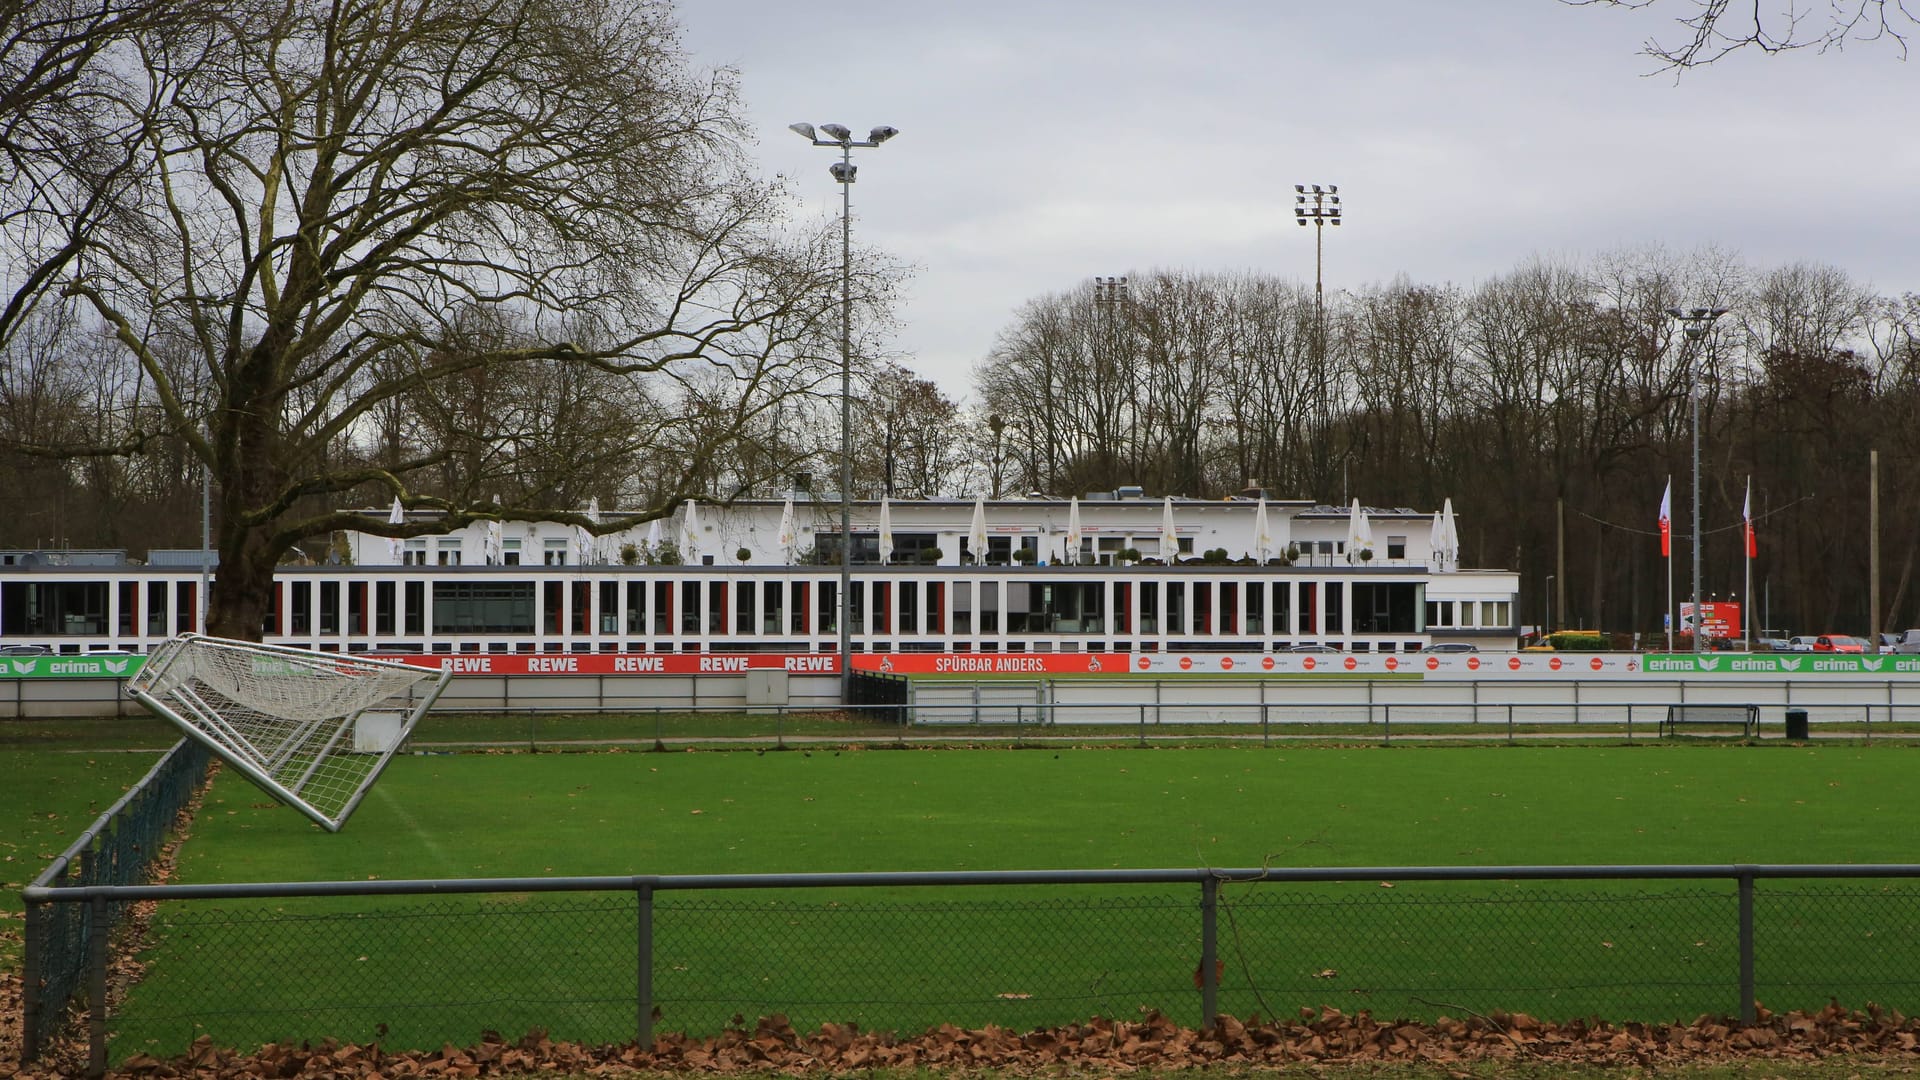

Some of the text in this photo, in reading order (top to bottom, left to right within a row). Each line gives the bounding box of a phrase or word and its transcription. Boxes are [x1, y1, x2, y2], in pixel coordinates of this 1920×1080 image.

[50, 660, 100, 674] erima
[441, 658, 491, 672] REWE
[528, 658, 577, 672] REWE
[614, 658, 664, 671] REWE
[700, 657, 748, 671] REWE
[785, 657, 833, 671] REWE
[936, 655, 1047, 672] SPÜRBAR ANDERS.
[1649, 658, 1694, 670] erima
[1731, 658, 1776, 670] erima
[1813, 658, 1858, 671] erima
[1895, 659, 1920, 671] eri
